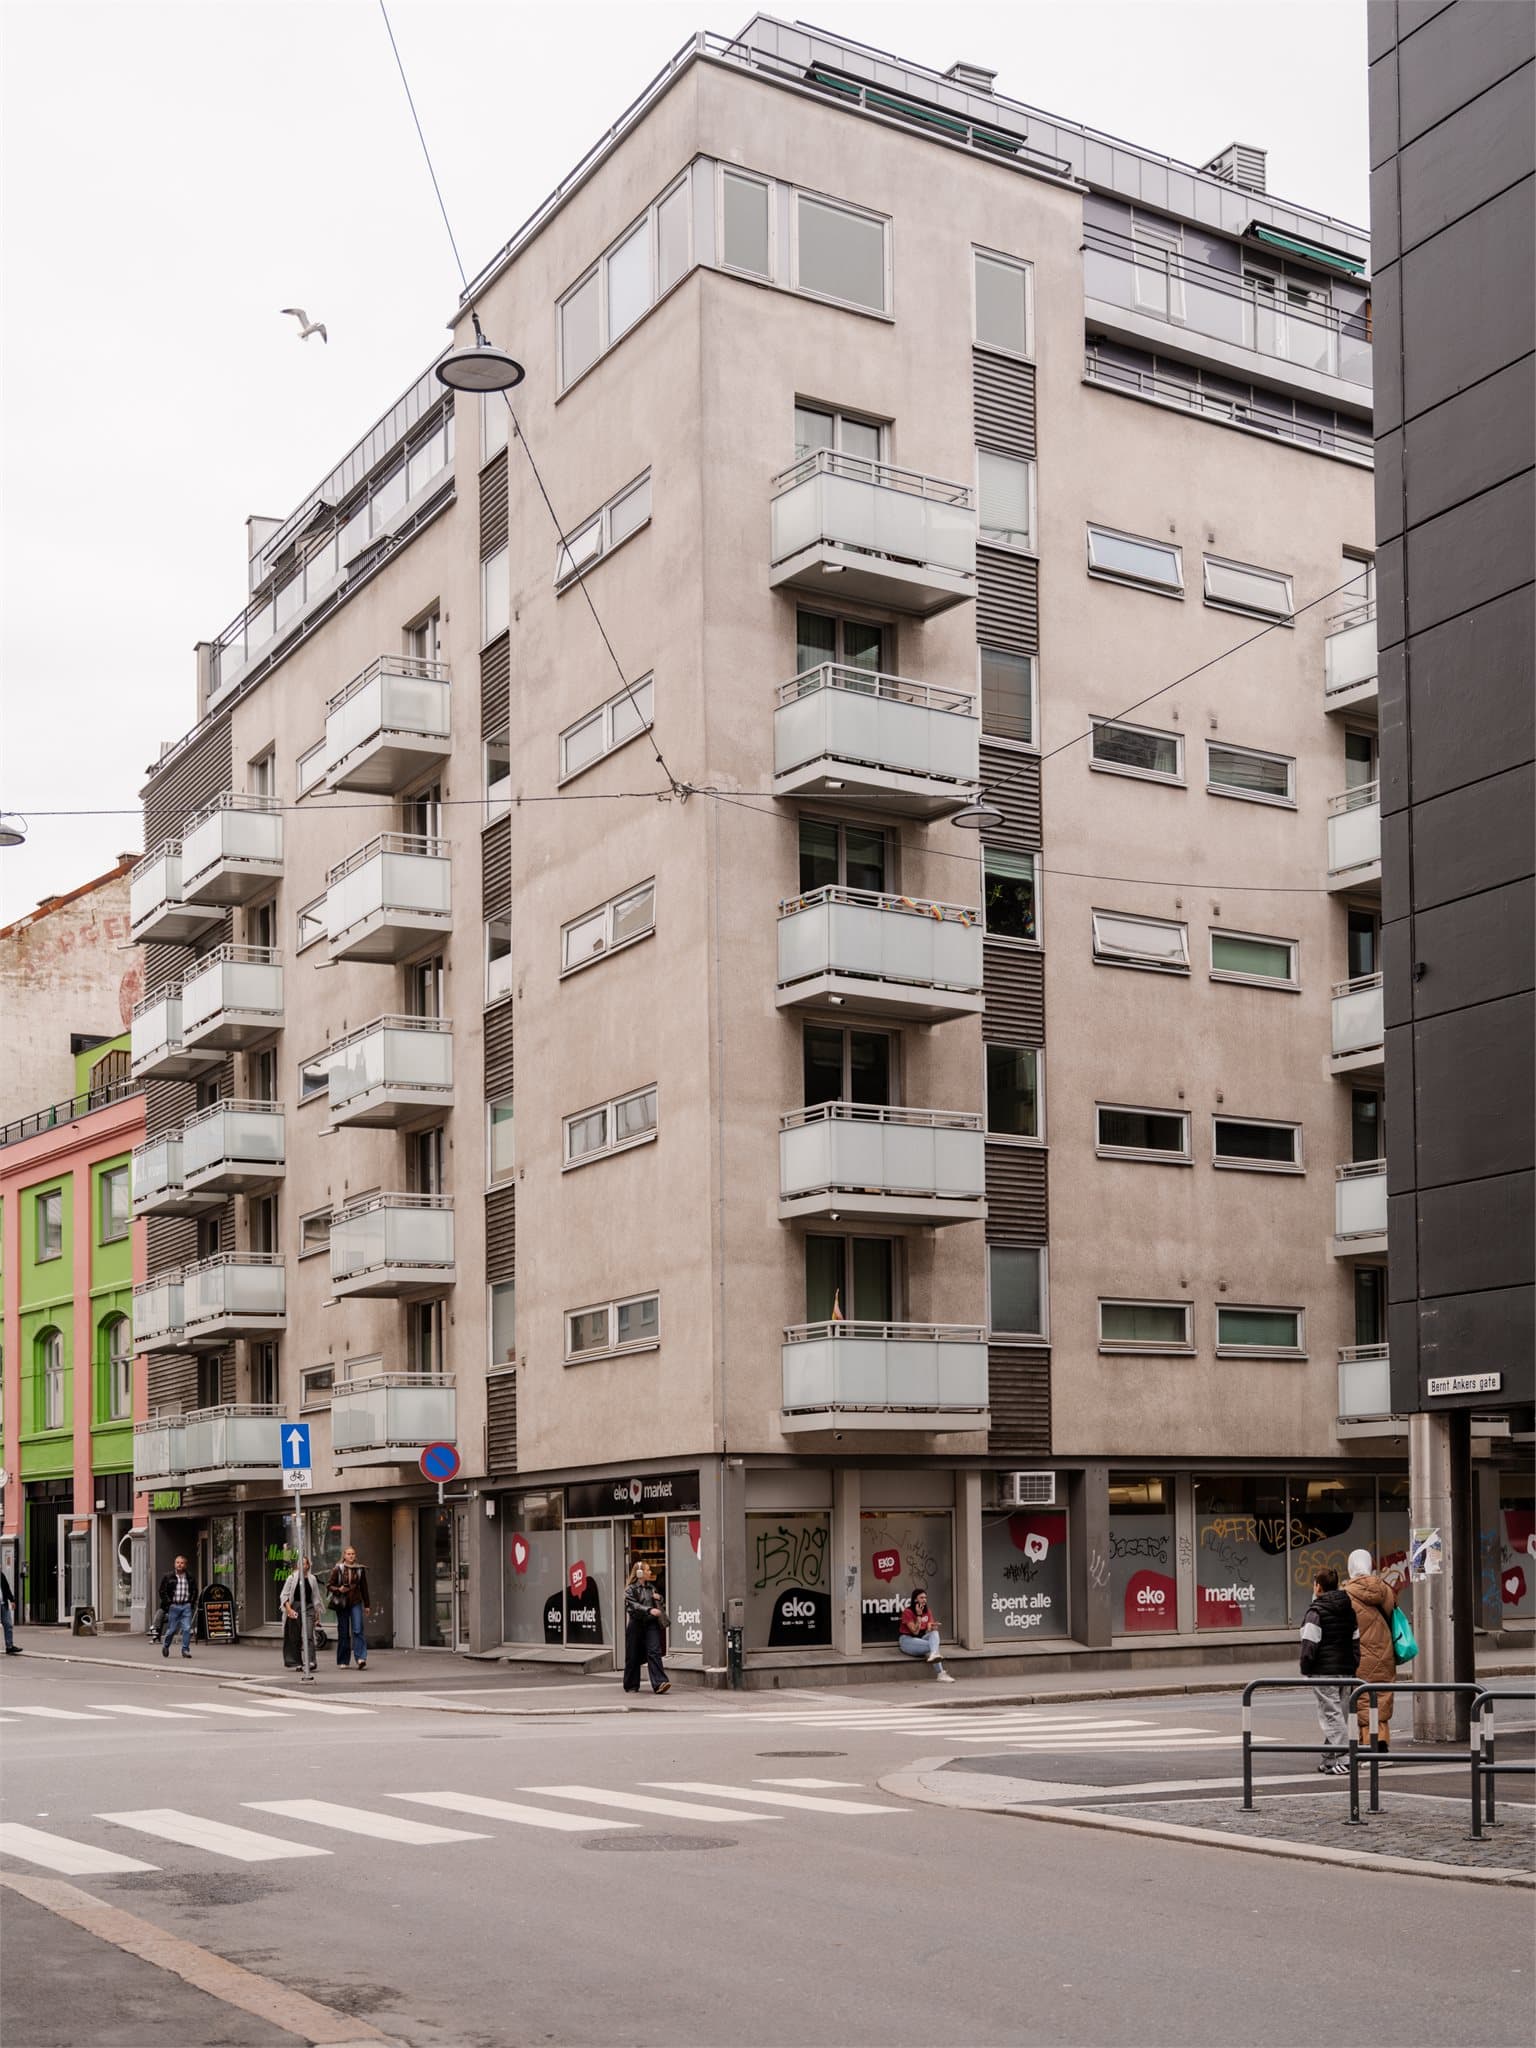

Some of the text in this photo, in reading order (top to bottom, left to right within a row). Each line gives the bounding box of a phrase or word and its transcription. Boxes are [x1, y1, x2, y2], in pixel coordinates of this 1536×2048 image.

[1431, 1376, 1496, 1392] Bernt Ankers gate
[613, 1481, 672, 1500] eko market
[1136, 1586, 1165, 1604] eko
[1205, 1583, 1255, 1601] market
[782, 1597, 816, 1617] eko
[862, 1594, 911, 1614] marke
[991, 1593, 1051, 1612] åpent alle
[547, 1607, 562, 1622] eko
[570, 1606, 596, 1622] market
[677, 1605, 700, 1626] åpent
[1004, 1612, 1042, 1629] dager
